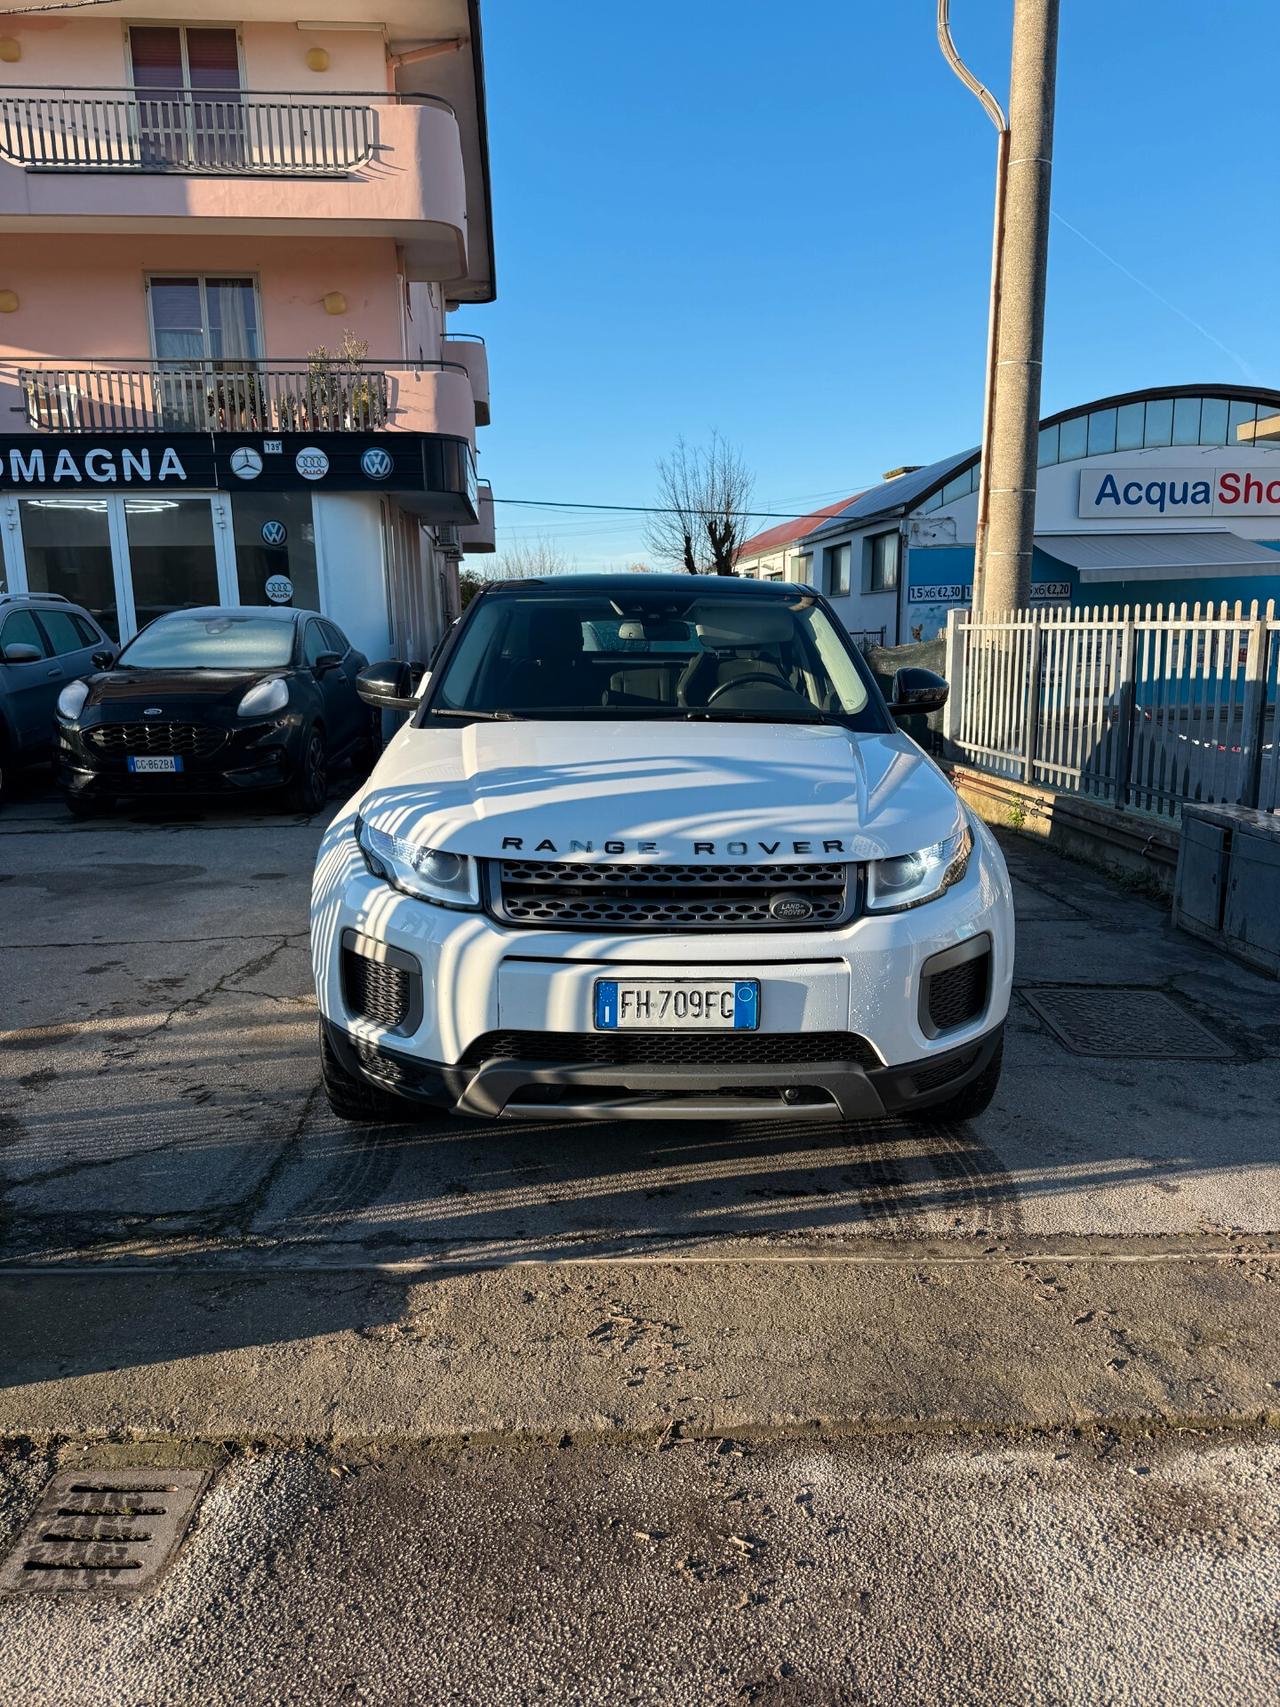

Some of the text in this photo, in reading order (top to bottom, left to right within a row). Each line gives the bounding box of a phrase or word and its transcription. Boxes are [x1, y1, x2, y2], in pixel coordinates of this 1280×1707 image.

[0, 447, 187, 482] MAGNA
[1095, 472, 1280, 513] Acqua Sho
[937, 585, 961, 598] €2,30
[1047, 583, 1069, 596] €2,20
[502, 836, 846, 856] RANGE ROVER
